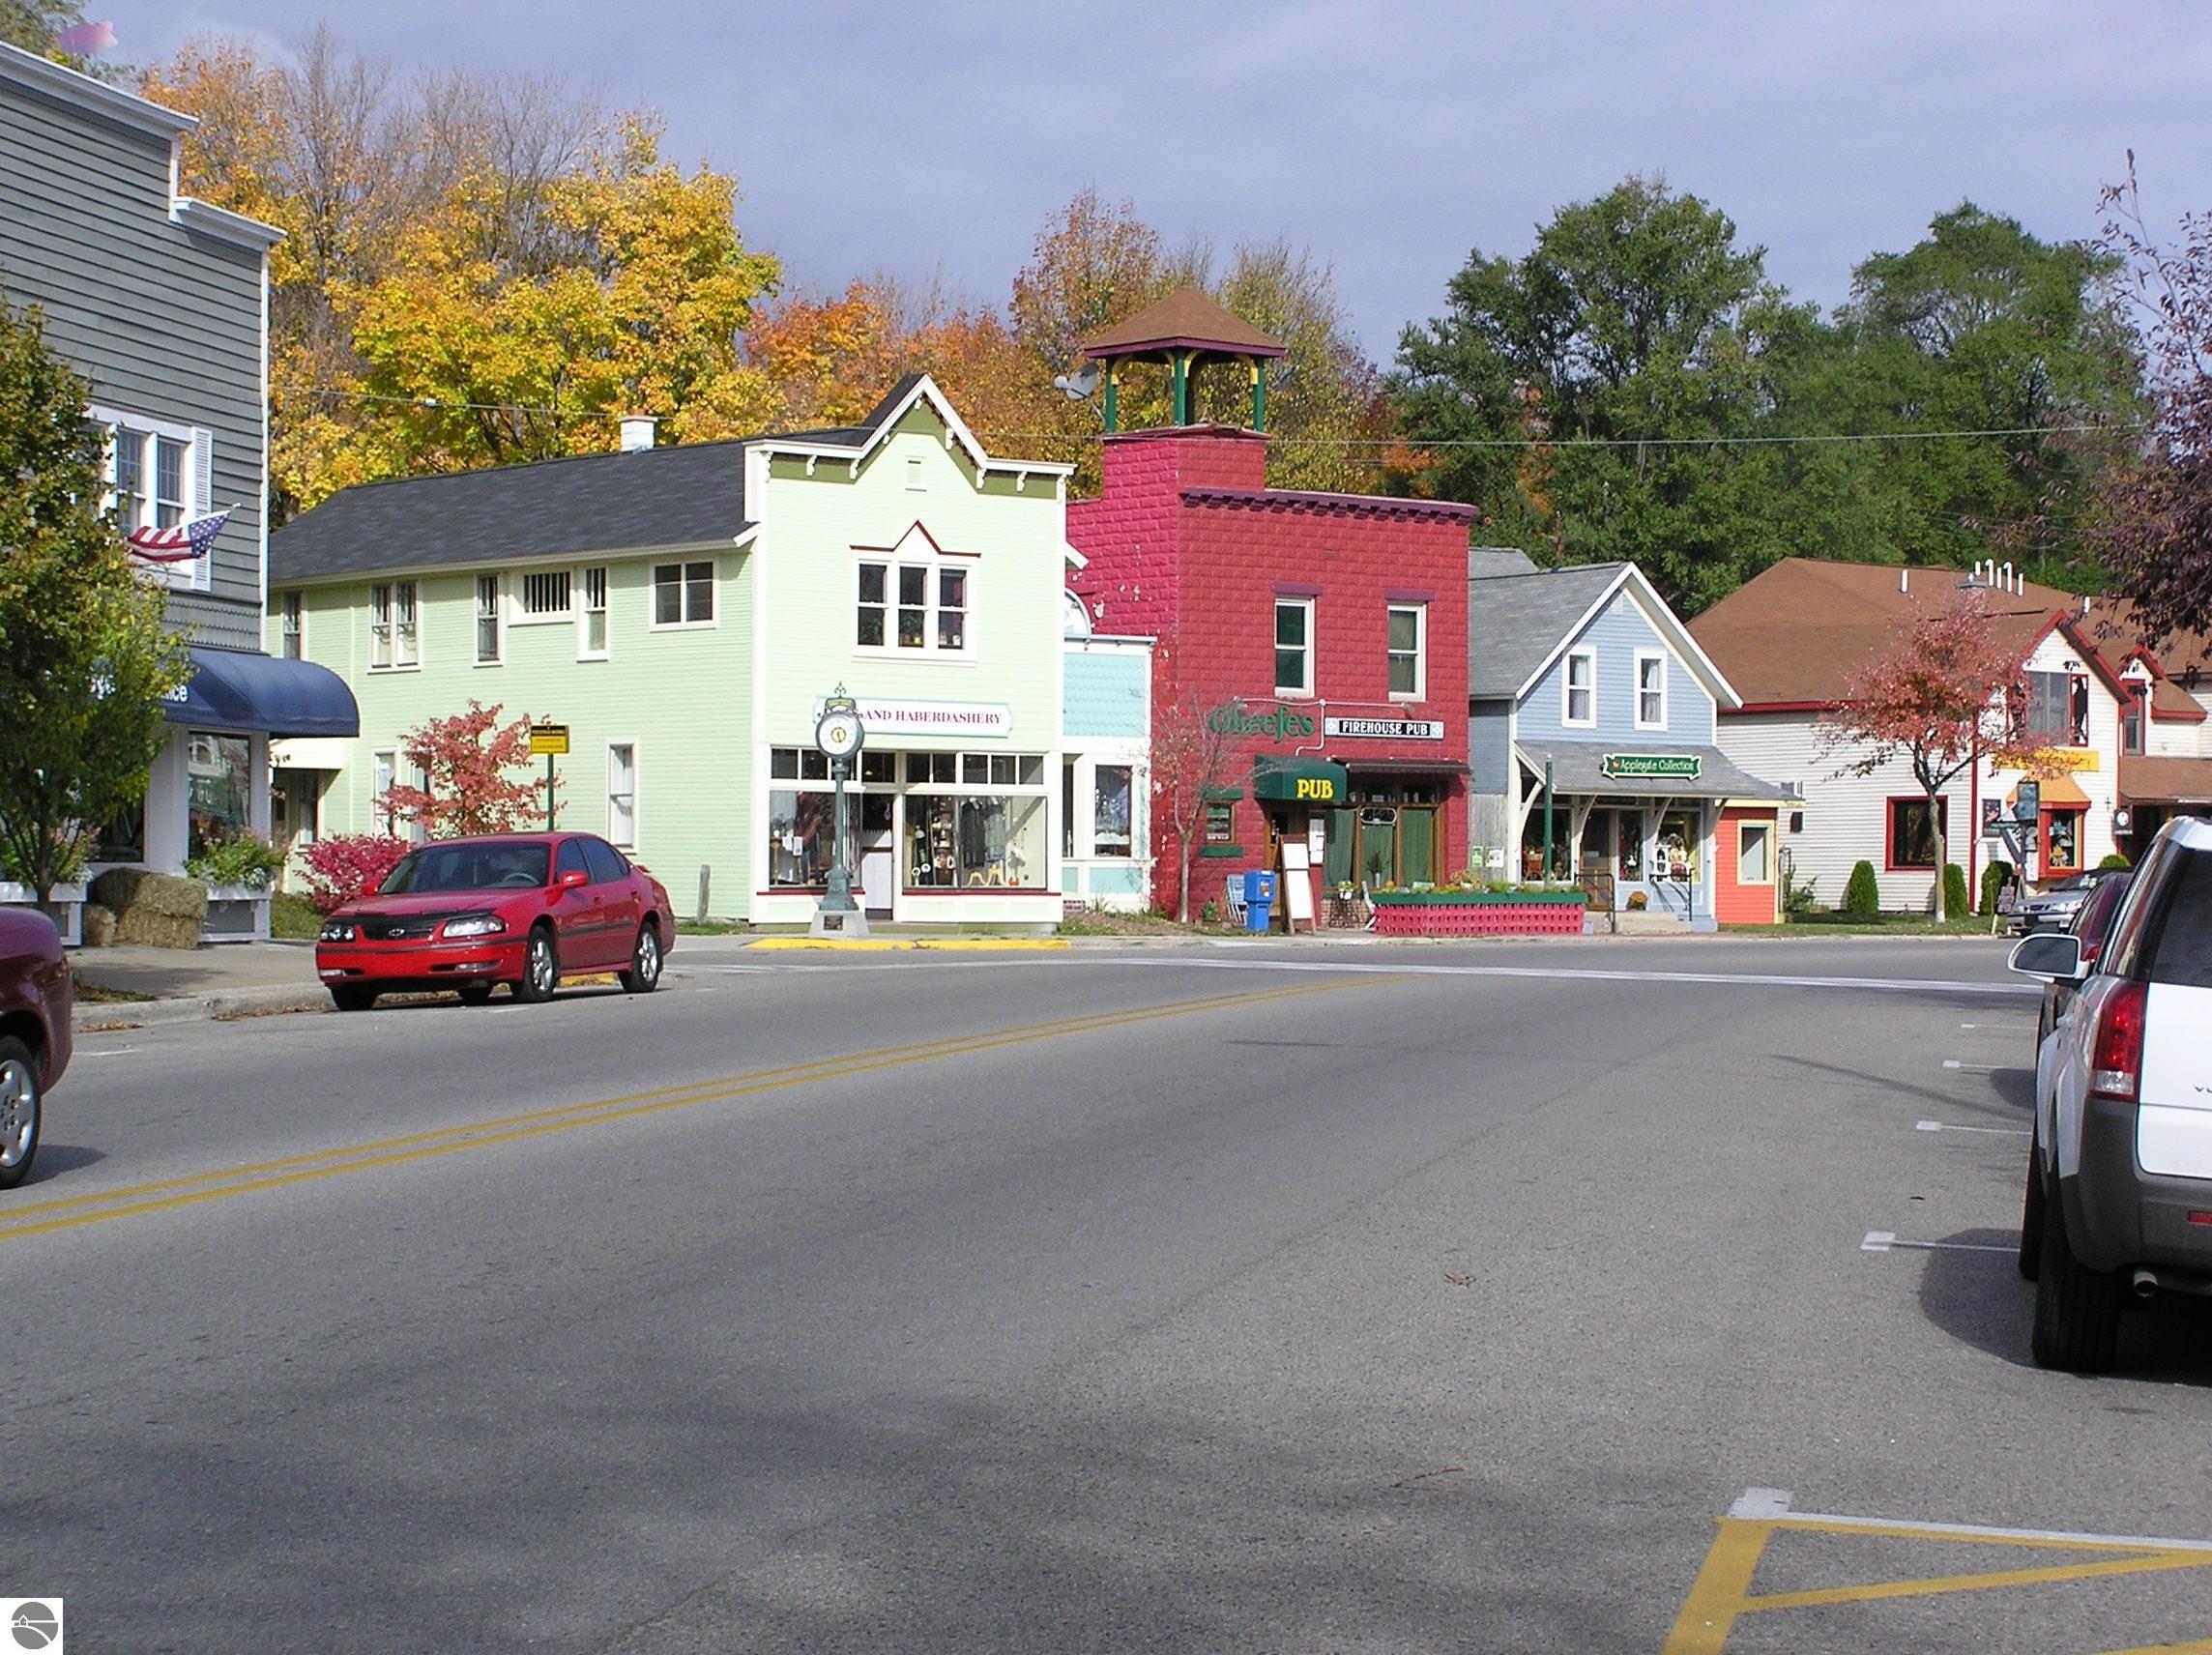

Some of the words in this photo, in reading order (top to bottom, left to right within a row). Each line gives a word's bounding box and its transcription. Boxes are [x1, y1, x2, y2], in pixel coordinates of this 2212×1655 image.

[895, 711, 1002, 724] HABERDASHERY
[1342, 721, 1402, 735] FIREHOUSE
[1406, 723, 1428, 736] PUB
[1658, 759, 1694, 771] Collection
[1296, 779, 1334, 798] PUB
